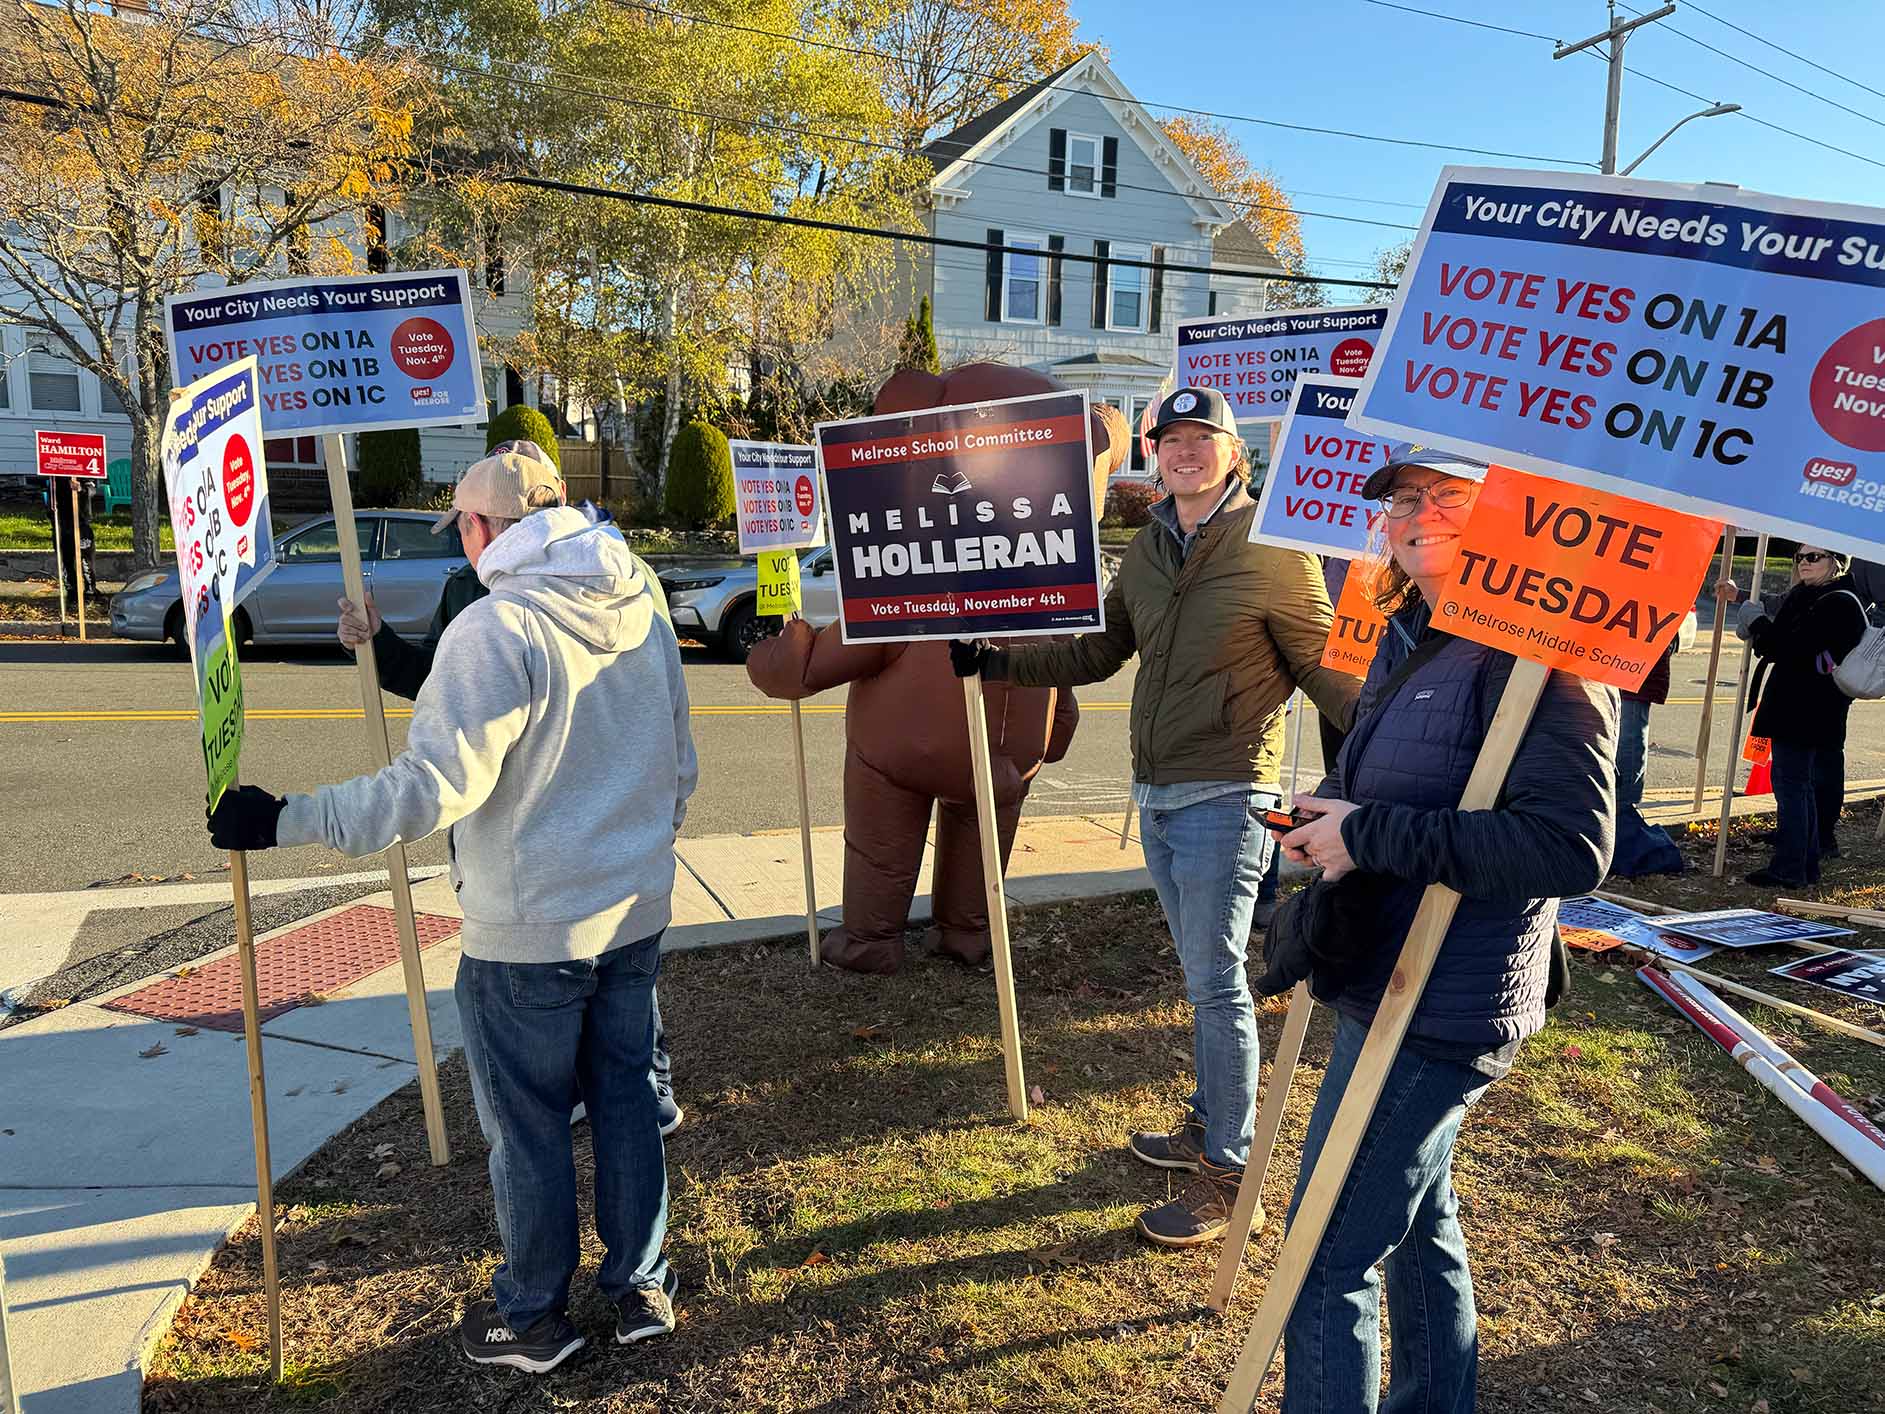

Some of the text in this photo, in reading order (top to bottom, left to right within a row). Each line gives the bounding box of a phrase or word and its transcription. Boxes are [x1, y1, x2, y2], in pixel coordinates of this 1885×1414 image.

[1463, 195, 1532, 226] Your
[1535, 198, 1606, 241] City
[1609, 207, 1728, 248] Needs
[1739, 222, 1831, 262] Your
[184, 283, 446, 323] Your City Needs Your Support
[1438, 262, 1788, 355] VOTE YES ON 1A
[408, 333, 433, 342] Vote
[1188, 313, 1378, 341] Your City Needs Your Support
[189, 329, 375, 364] VOTE YES ON 1A
[1188, 347, 1320, 369] VOTE YES ON 1A
[1421, 311, 1774, 410] VOTE YES ON 1B
[258, 357, 380, 384] YES ON 1B
[406, 357, 430, 365] Nov.
[1188, 373, 1231, 388] VOTE
[1236, 371, 1267, 386] YES
[1271, 368, 1297, 382] ON
[207, 380, 247, 421] Support
[263, 385, 386, 412] YES ON 1C
[1236, 392, 1266, 407] YES
[1316, 392, 1353, 412] You
[1403, 359, 1755, 466] VOTE YES ON 1C
[40, 436, 61, 444] Ward
[40, 444, 102, 457] HAMILTON
[851, 427, 1054, 462] Melrose School Committee
[1304, 434, 1376, 464] VOTE
[86, 457, 100, 474] 4
[1808, 462, 1853, 482] yes!
[741, 480, 760, 493] VOTE
[761, 480, 774, 493] YES
[1295, 465, 1368, 495] VOTE
[744, 500, 762, 513] VOTE
[763, 500, 776, 512] YES
[849, 493, 1072, 534] MELISSA
[1285, 495, 1358, 527] VOTE
[745, 520, 764, 534] VOTE
[765, 519, 778, 532] YES
[1523, 495, 1663, 570] VOTE
[852, 528, 1076, 579] HOLLERAN
[871, 592, 1065, 616] Vote Tuesday, November 4th
[1458, 549, 1679, 645] TUESDAY
[1442, 600, 1647, 676] @ Melrose Middle School
